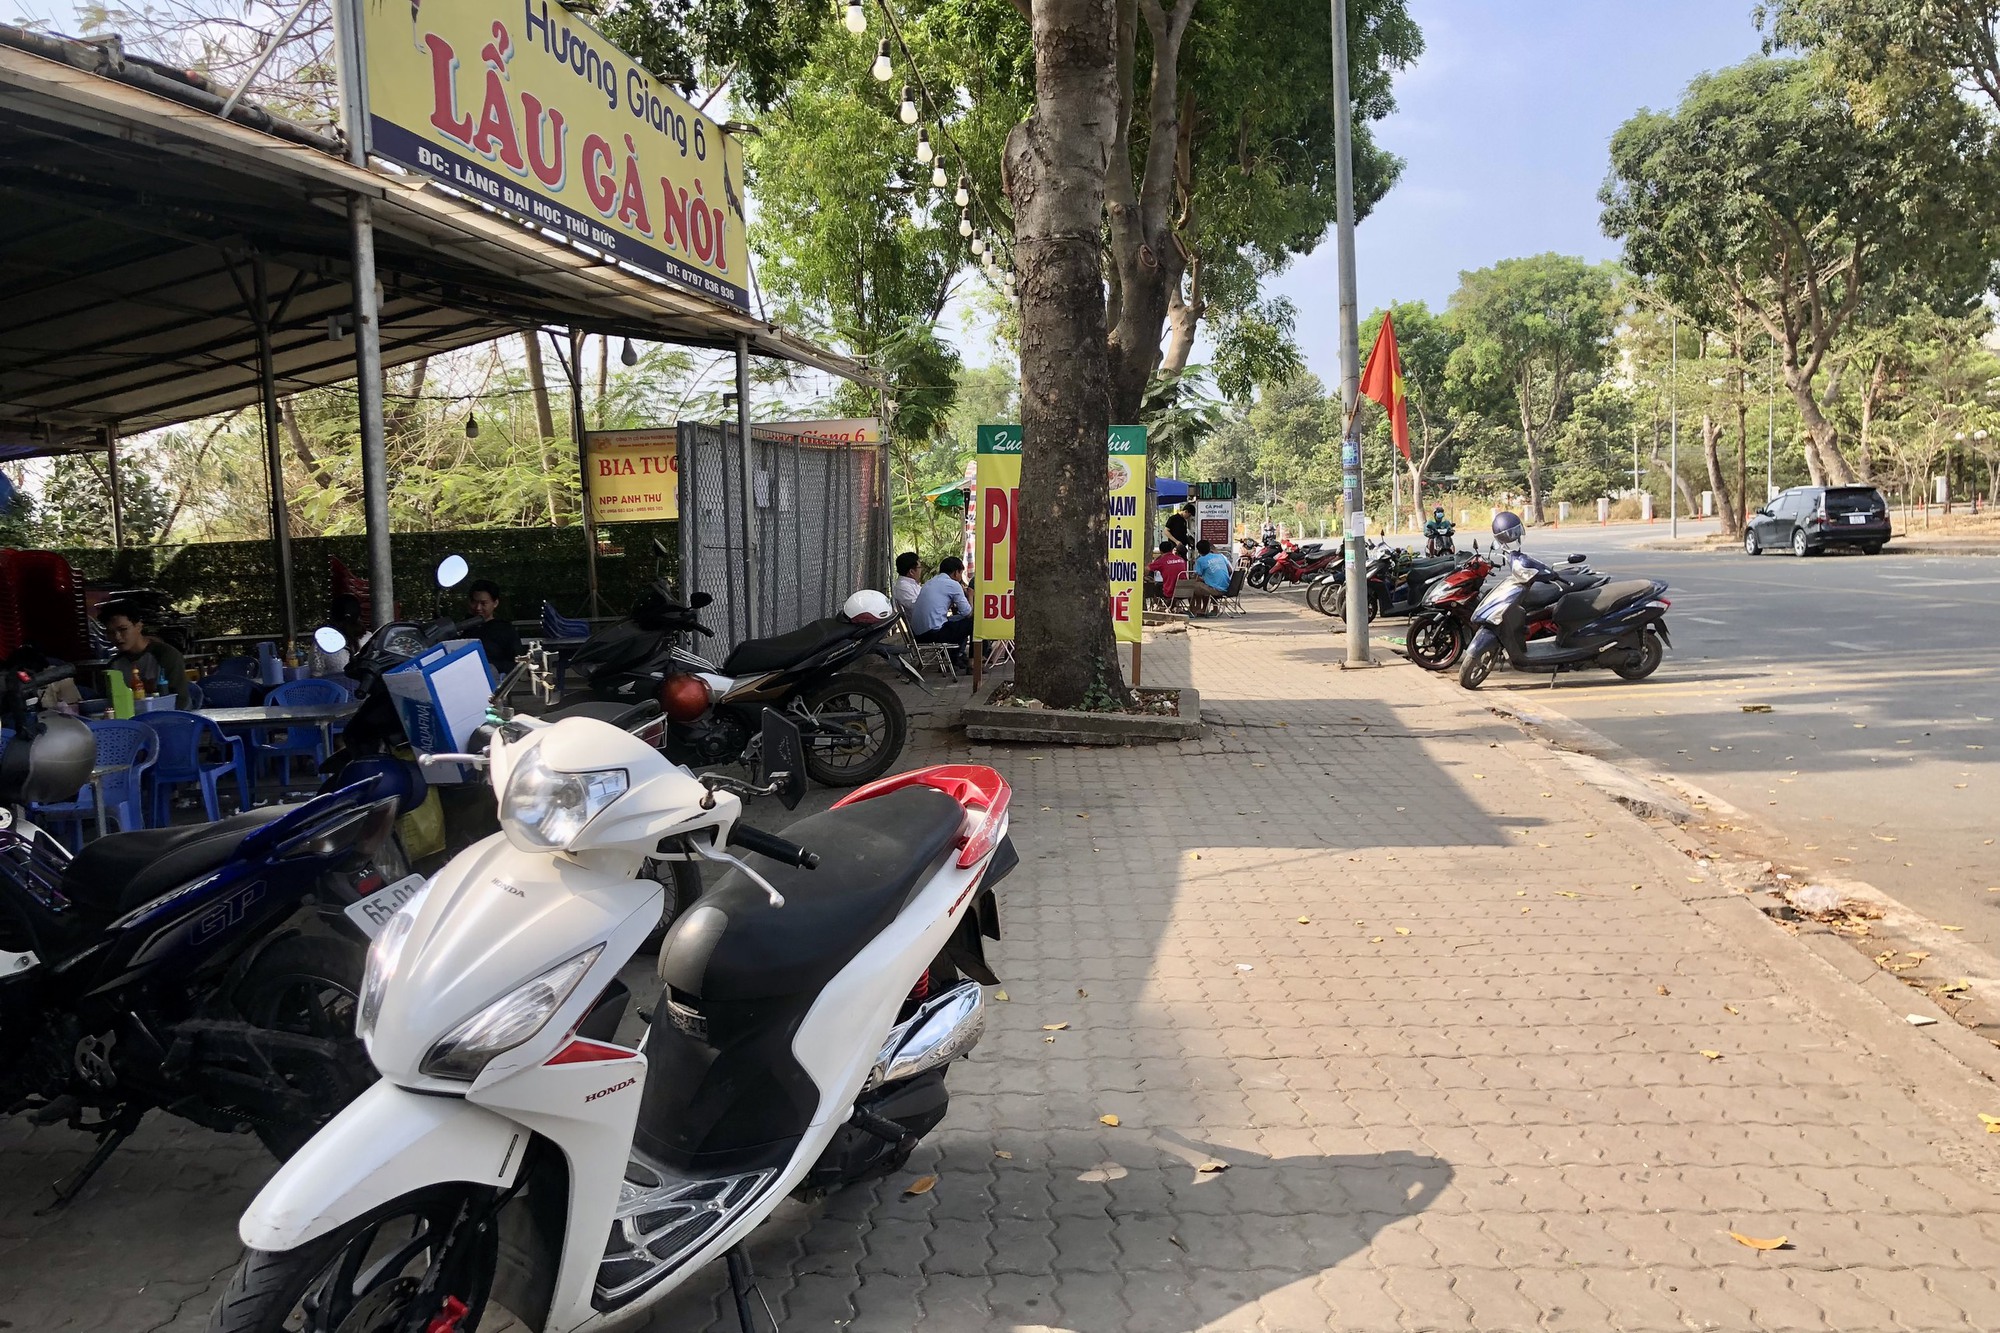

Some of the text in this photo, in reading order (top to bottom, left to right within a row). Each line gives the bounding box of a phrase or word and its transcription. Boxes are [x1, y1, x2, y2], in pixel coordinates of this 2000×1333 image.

[525, 0, 706, 161] Hương Giang 6
[424, 20, 728, 274] LẨU GÀ NÒI
[418, 146, 616, 249] ĐC: LÀNG ĐẠI HỌC THỦ ĐỨC
[666, 261, 735, 300] ĐT: 0797 836 936
[854, 427, 865, 443] 6
[598, 458, 636, 477] BIA
[599, 493, 662, 505] NPP ANH THƯ
[415, 703, 435, 753] AQUAFINA
[491, 877, 525, 898] HONDA
[190, 880, 267, 946] GP
[584, 1077, 637, 1103] HONDA
